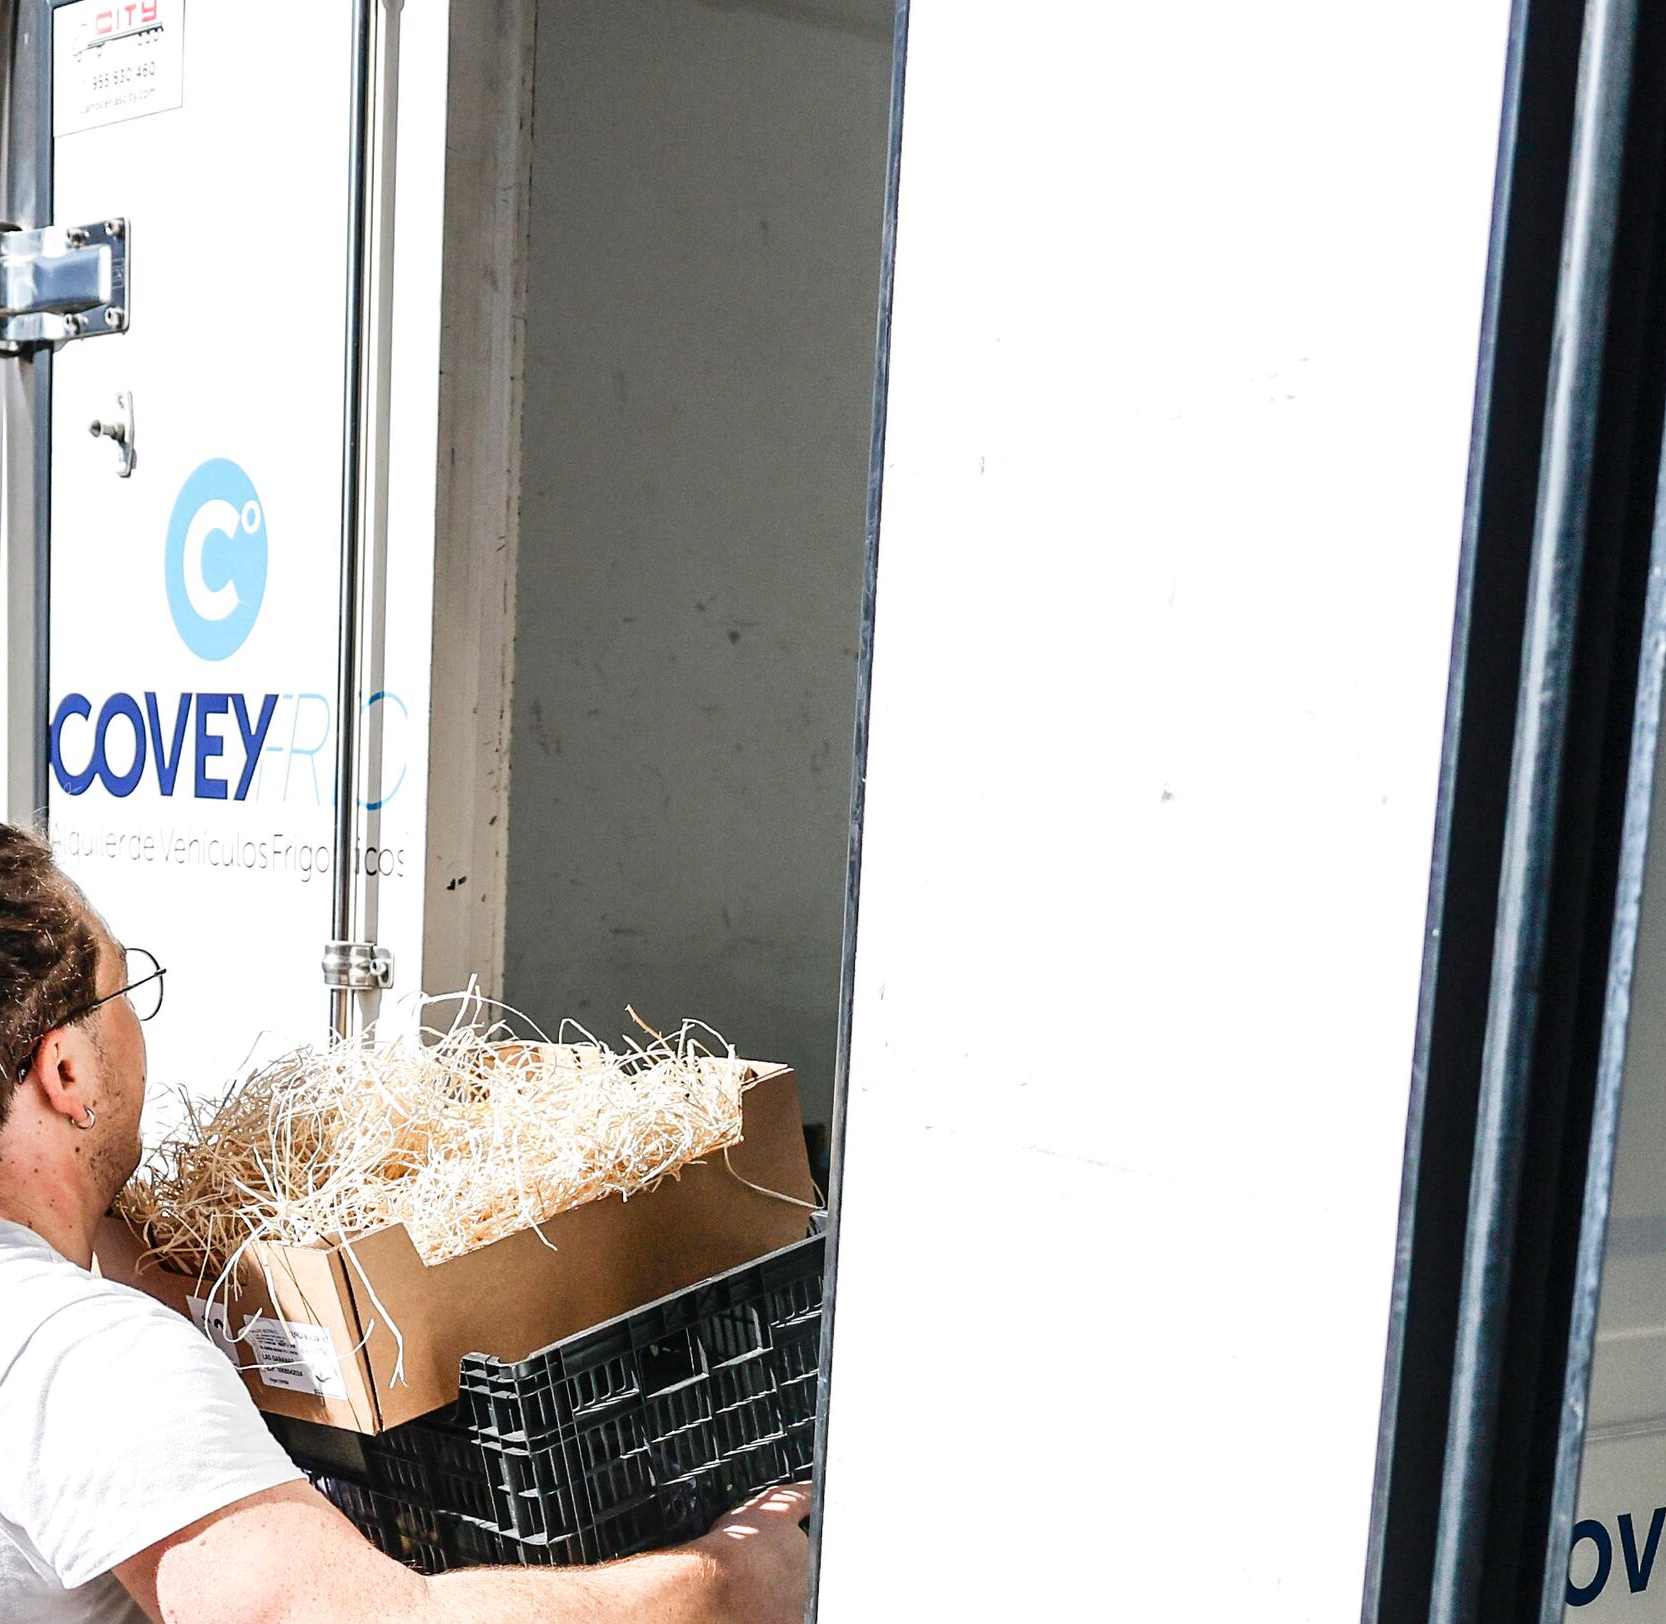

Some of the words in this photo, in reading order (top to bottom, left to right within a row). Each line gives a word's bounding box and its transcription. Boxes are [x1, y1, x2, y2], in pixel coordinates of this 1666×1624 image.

[96, 0, 157, 35] CITY
[129, 824, 155, 862] de
[159, 827, 269, 870] Vehículos
